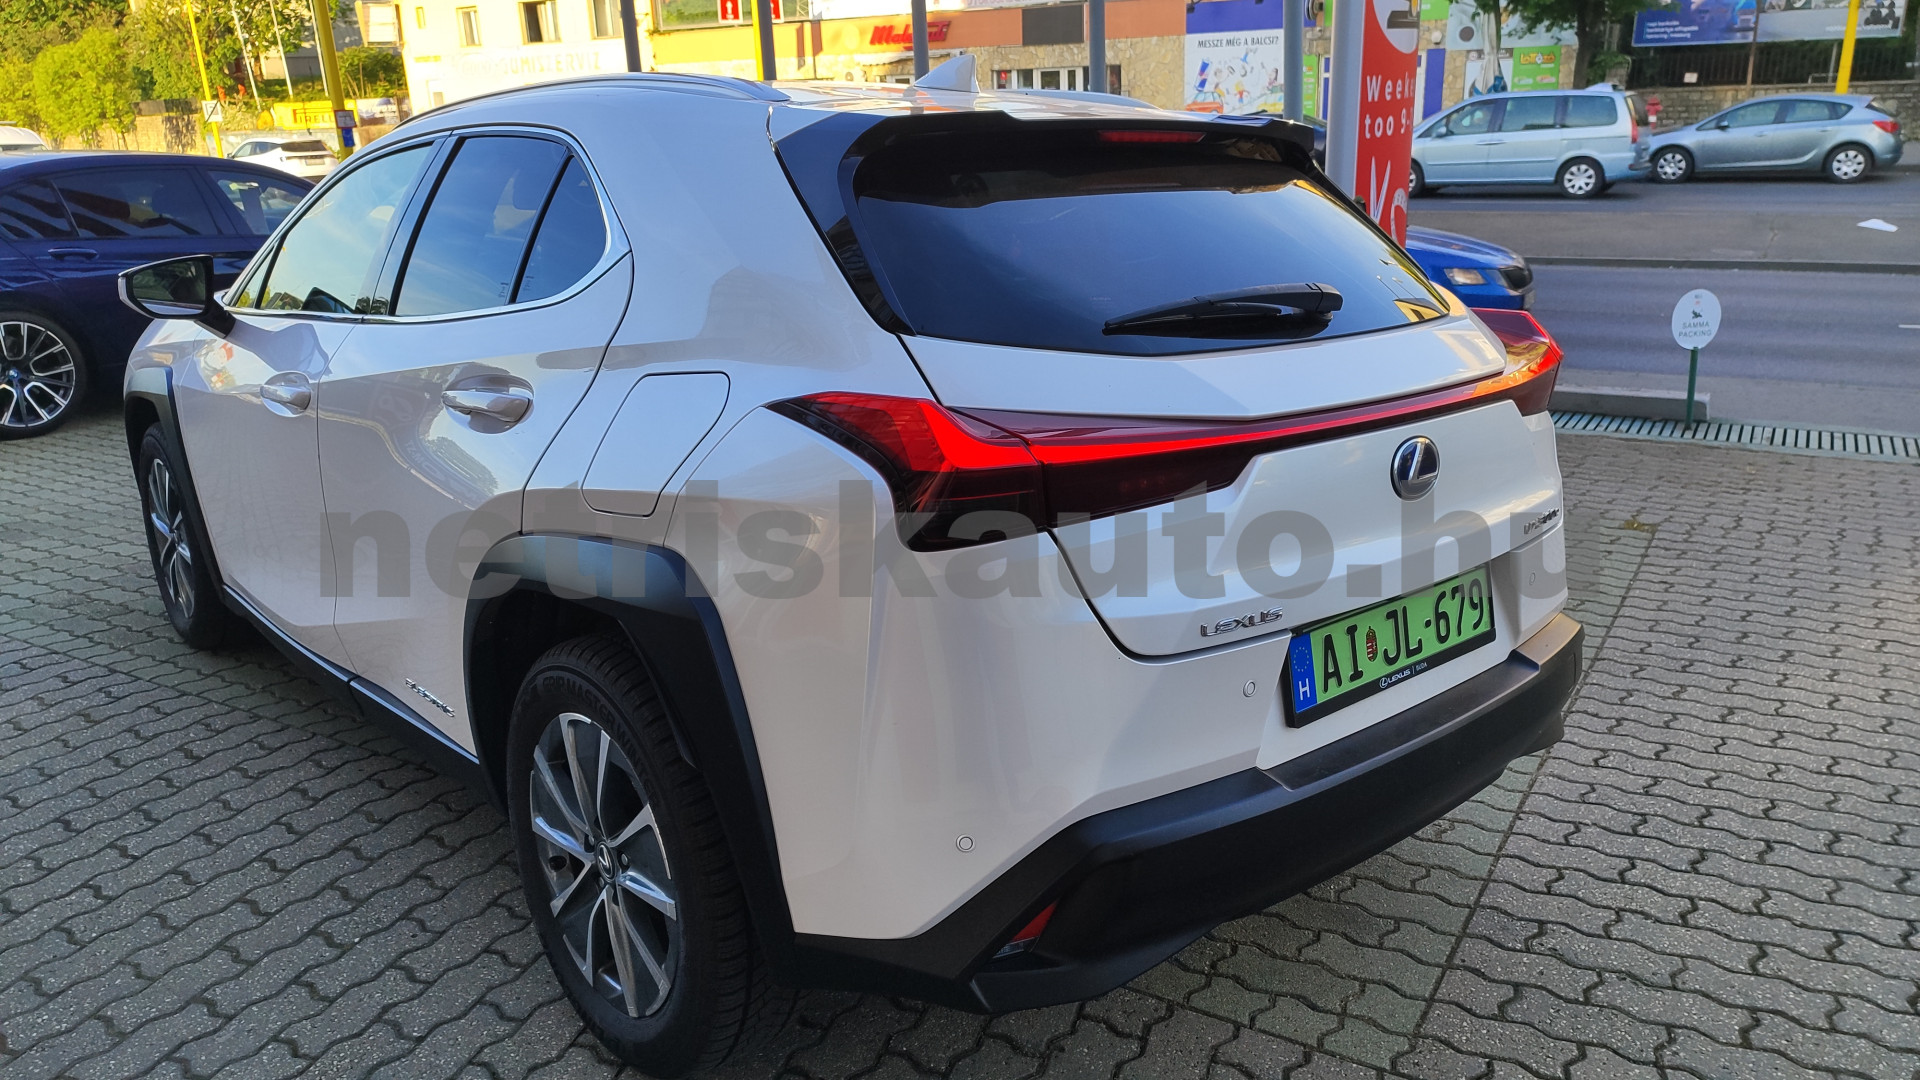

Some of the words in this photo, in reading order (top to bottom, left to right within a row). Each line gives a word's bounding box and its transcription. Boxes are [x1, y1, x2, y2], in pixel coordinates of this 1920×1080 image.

[1197, 38, 1224, 49] MESSZE
[1225, 36, 1242, 47] MÉG
[1243, 37, 1248, 46] A
[1250, 35, 1279, 46] BALCSI?
[1366, 71, 1414, 103] Weeke
[1364, 113, 1394, 139] too
[1678, 329, 1712, 338] PACKING
[1681, 321, 1710, 330] SAMMA
[1200, 606, 1284, 638] LEXUS
[1387, 668, 1411, 684] LEXUS
[1298, 680, 1311, 701] H
